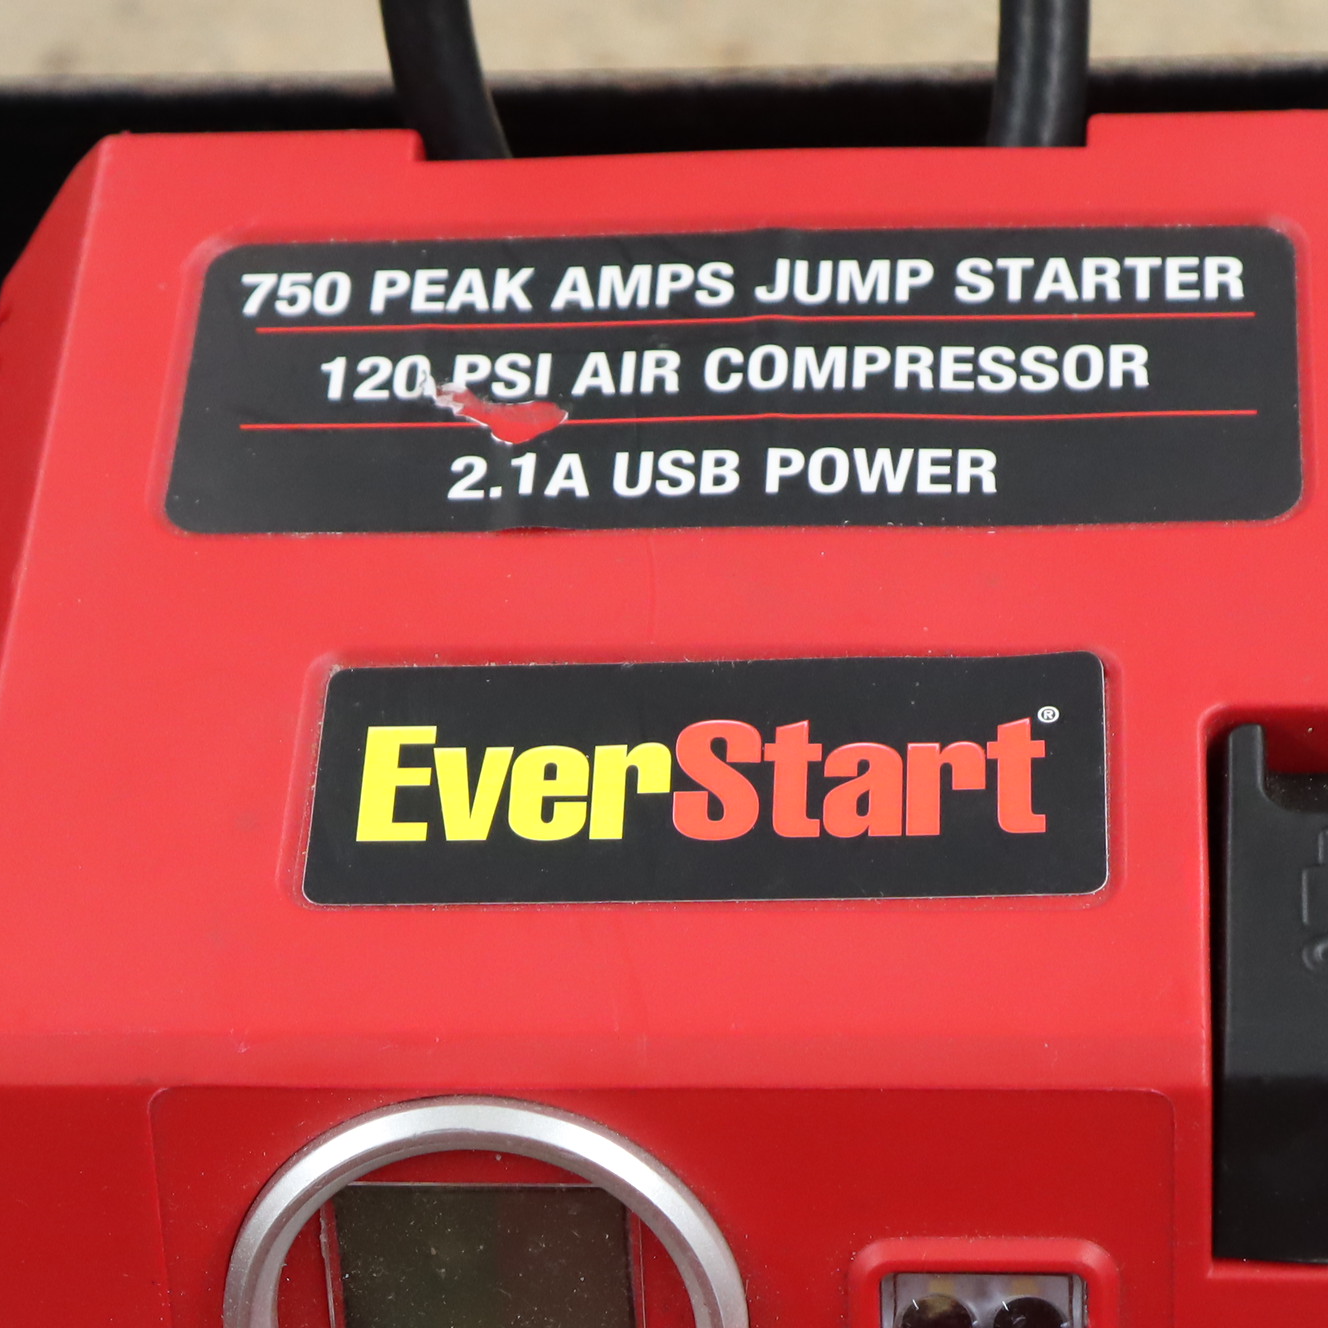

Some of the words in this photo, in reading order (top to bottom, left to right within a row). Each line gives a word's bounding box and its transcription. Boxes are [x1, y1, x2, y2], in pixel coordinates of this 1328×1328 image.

[241, 270, 352, 318] 750
[369, 266, 536, 315] PEAK
[550, 261, 736, 311] AMPS
[754, 257, 935, 305] JUMP
[954, 255, 1245, 303] STARTER
[319, 354, 434, 401] 120
[452, 352, 553, 399] PSI
[571, 348, 681, 397] AIR
[703, 343, 1150, 395] COMPRESSOR
[447, 452, 590, 500] 2.1A
[612, 448, 740, 498] USB
[764, 446, 998, 496] POWER
